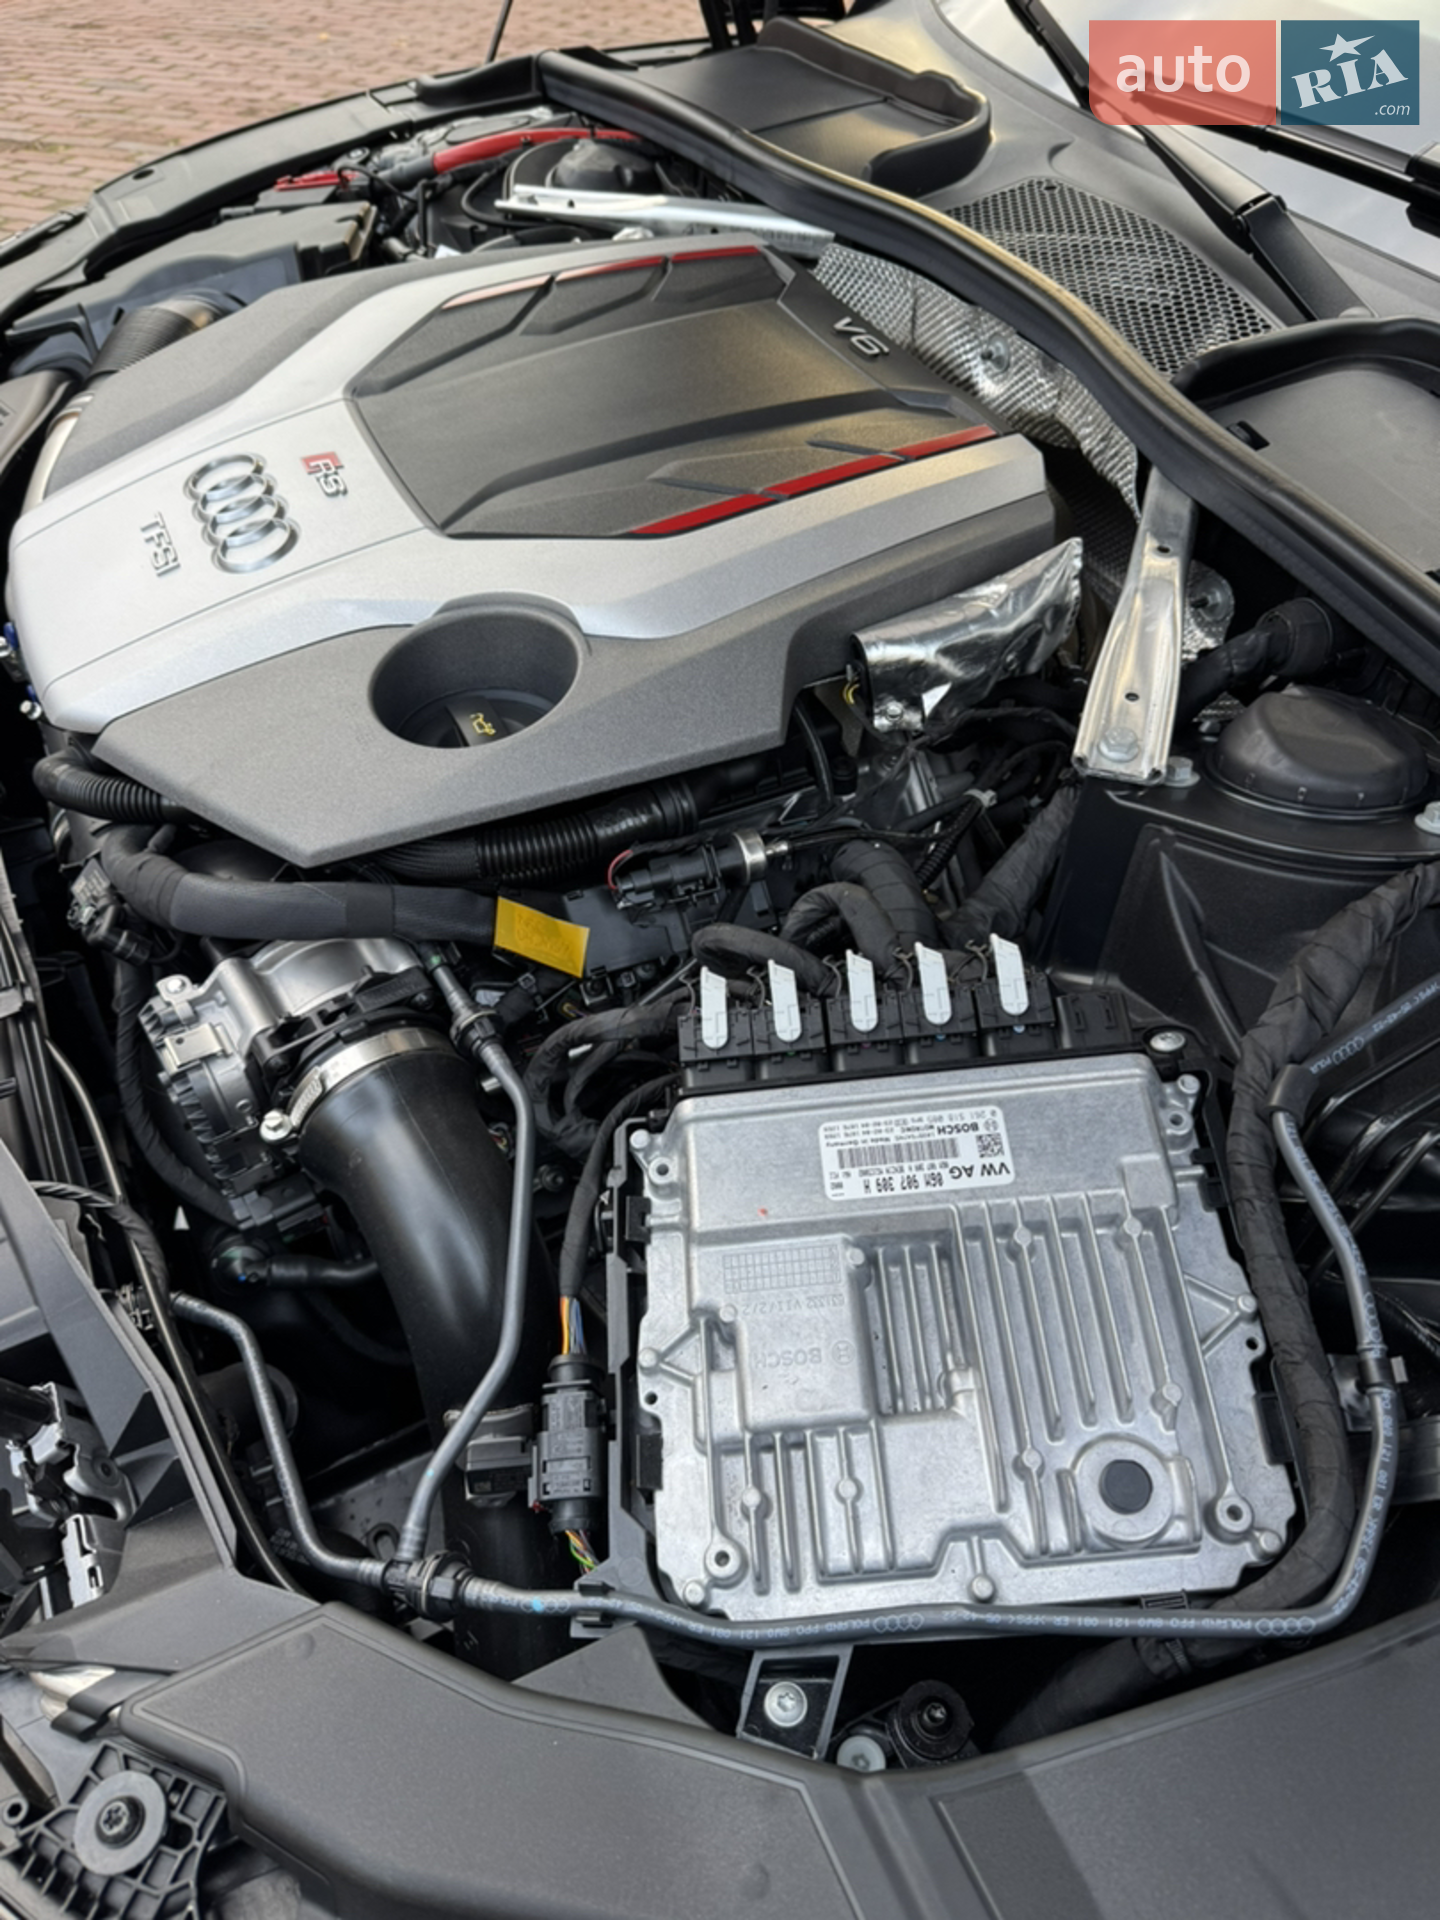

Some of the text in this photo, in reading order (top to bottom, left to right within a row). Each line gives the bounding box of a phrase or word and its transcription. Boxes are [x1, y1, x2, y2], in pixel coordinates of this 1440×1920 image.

[833, 315, 890, 355] V6
[301, 453, 348, 498] RS
[140, 511, 181, 578] TFSI
[937, 1121, 980, 1135] BOSCH
[948, 1164, 975, 1180] AG
[980, 1162, 1011, 1177] VW
[900, 1174, 920, 1191] 907
[754, 1347, 822, 1370] BOSCH
[1379, 1443, 1391, 1463] 121
[1370, 1494, 1384, 1512] ER
[687, 1621, 705, 1635] ER
[824, 1617, 871, 1631] POLAND
[1053, 1615, 1070, 1626] ER
[1109, 1616, 1131, 1628] 121
[1201, 1617, 1252, 1630] POLAND
[739, 1629, 760, 1640] 121
